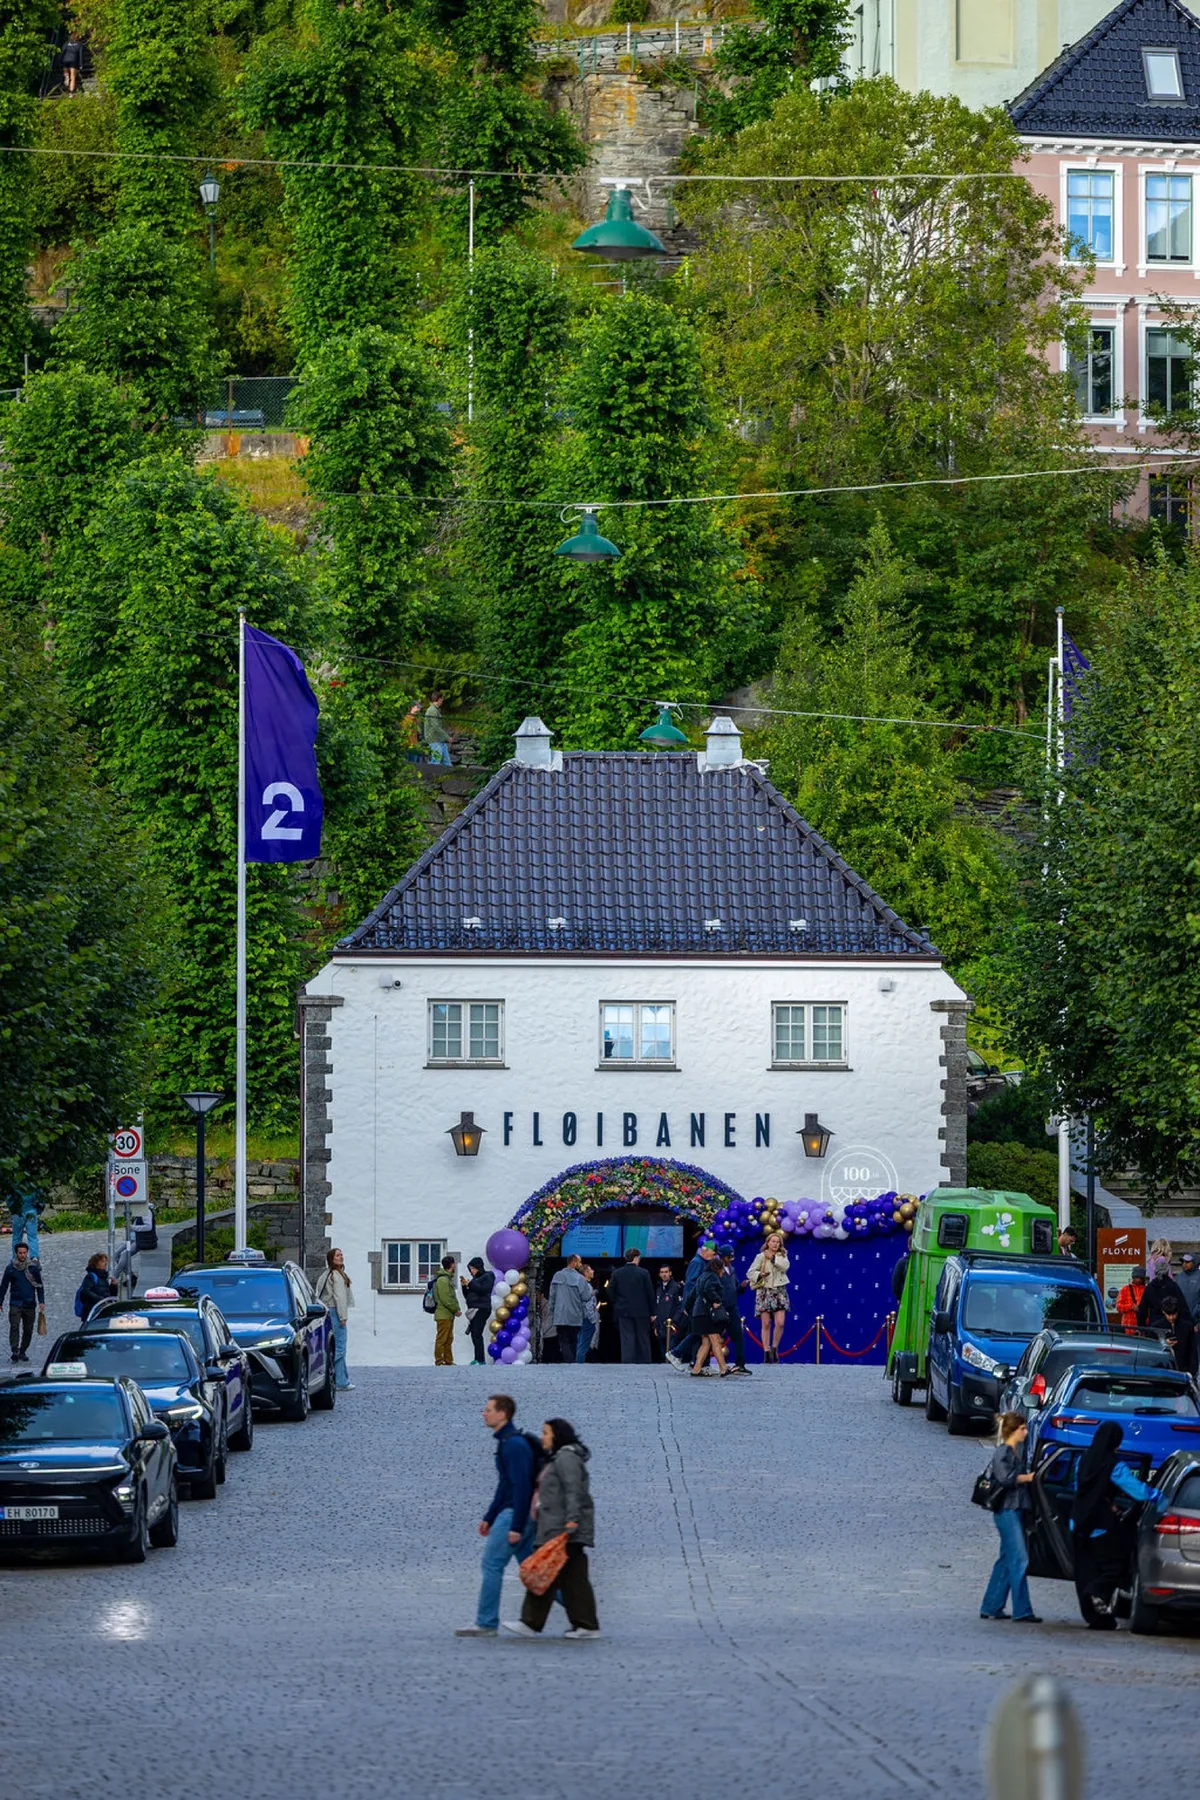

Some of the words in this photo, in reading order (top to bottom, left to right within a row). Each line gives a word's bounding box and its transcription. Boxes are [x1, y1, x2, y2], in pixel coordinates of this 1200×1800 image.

[261, 782, 305, 840] 2
[503, 1111, 770, 1148] FLØIBANEN
[117, 1135, 135, 1150] 30
[114, 1165, 140, 1175] Sone
[844, 1167, 870, 1181] 100
[7, 1508, 21, 1518] EH
